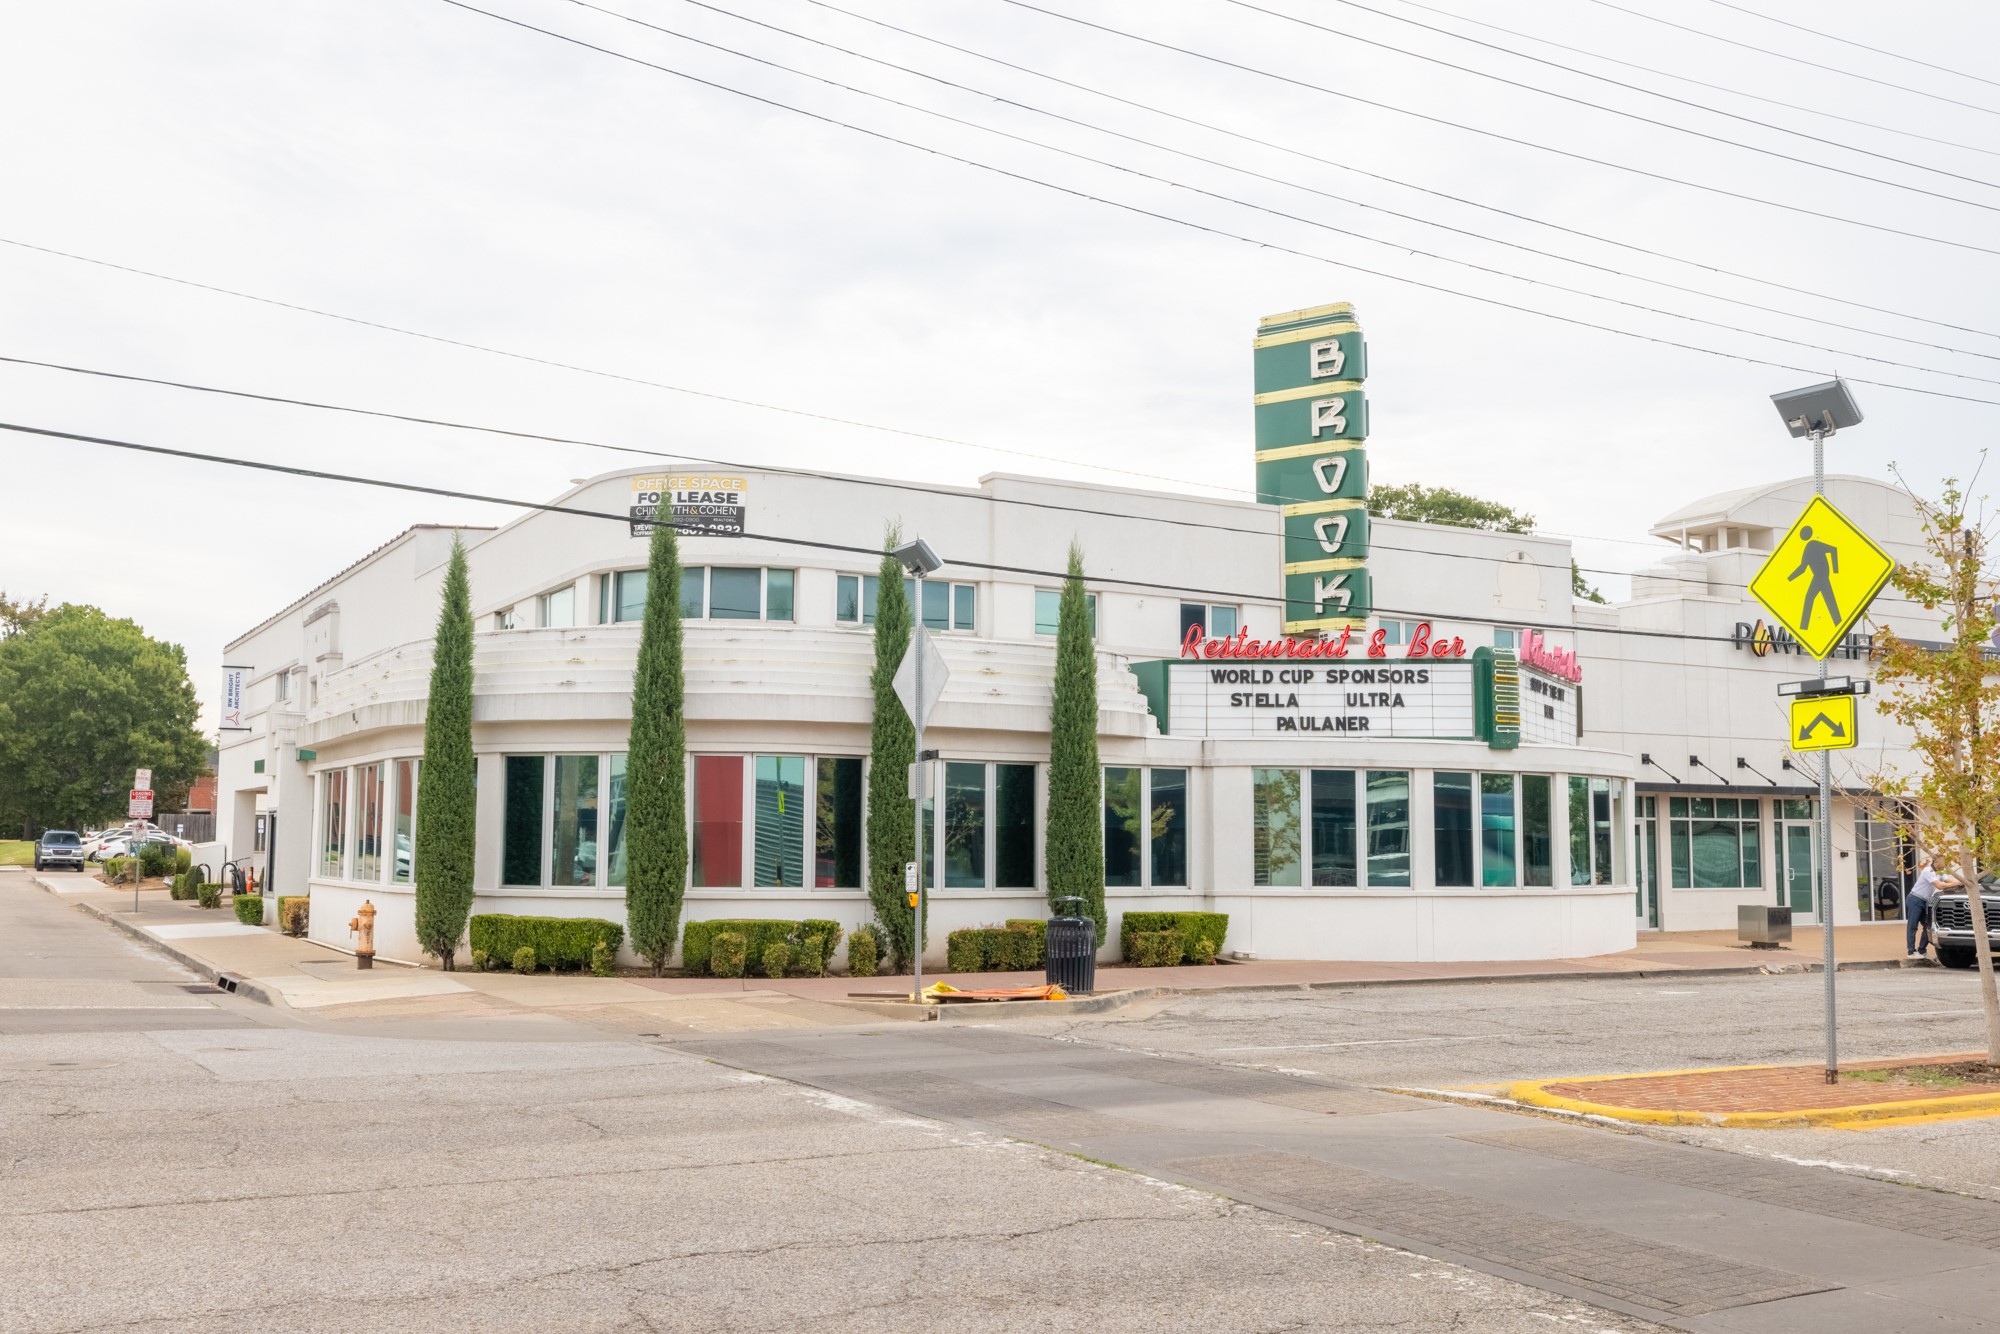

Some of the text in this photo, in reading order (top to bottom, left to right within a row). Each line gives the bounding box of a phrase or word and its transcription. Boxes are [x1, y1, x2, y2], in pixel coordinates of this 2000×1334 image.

[1310, 338, 1352, 614] BROOK
[637, 478, 742, 490] OFFICE SPACE
[677, 492, 738, 504] LEASE
[1181, 623, 1466, 660] Restaurant & Bar
[1211, 669, 1430, 684] WORLD CUP SPONSORS
[228, 698, 232, 707] RW
[1230, 693, 1405, 708] STELLA ULTRA
[1276, 717, 1370, 732] PAULANER
